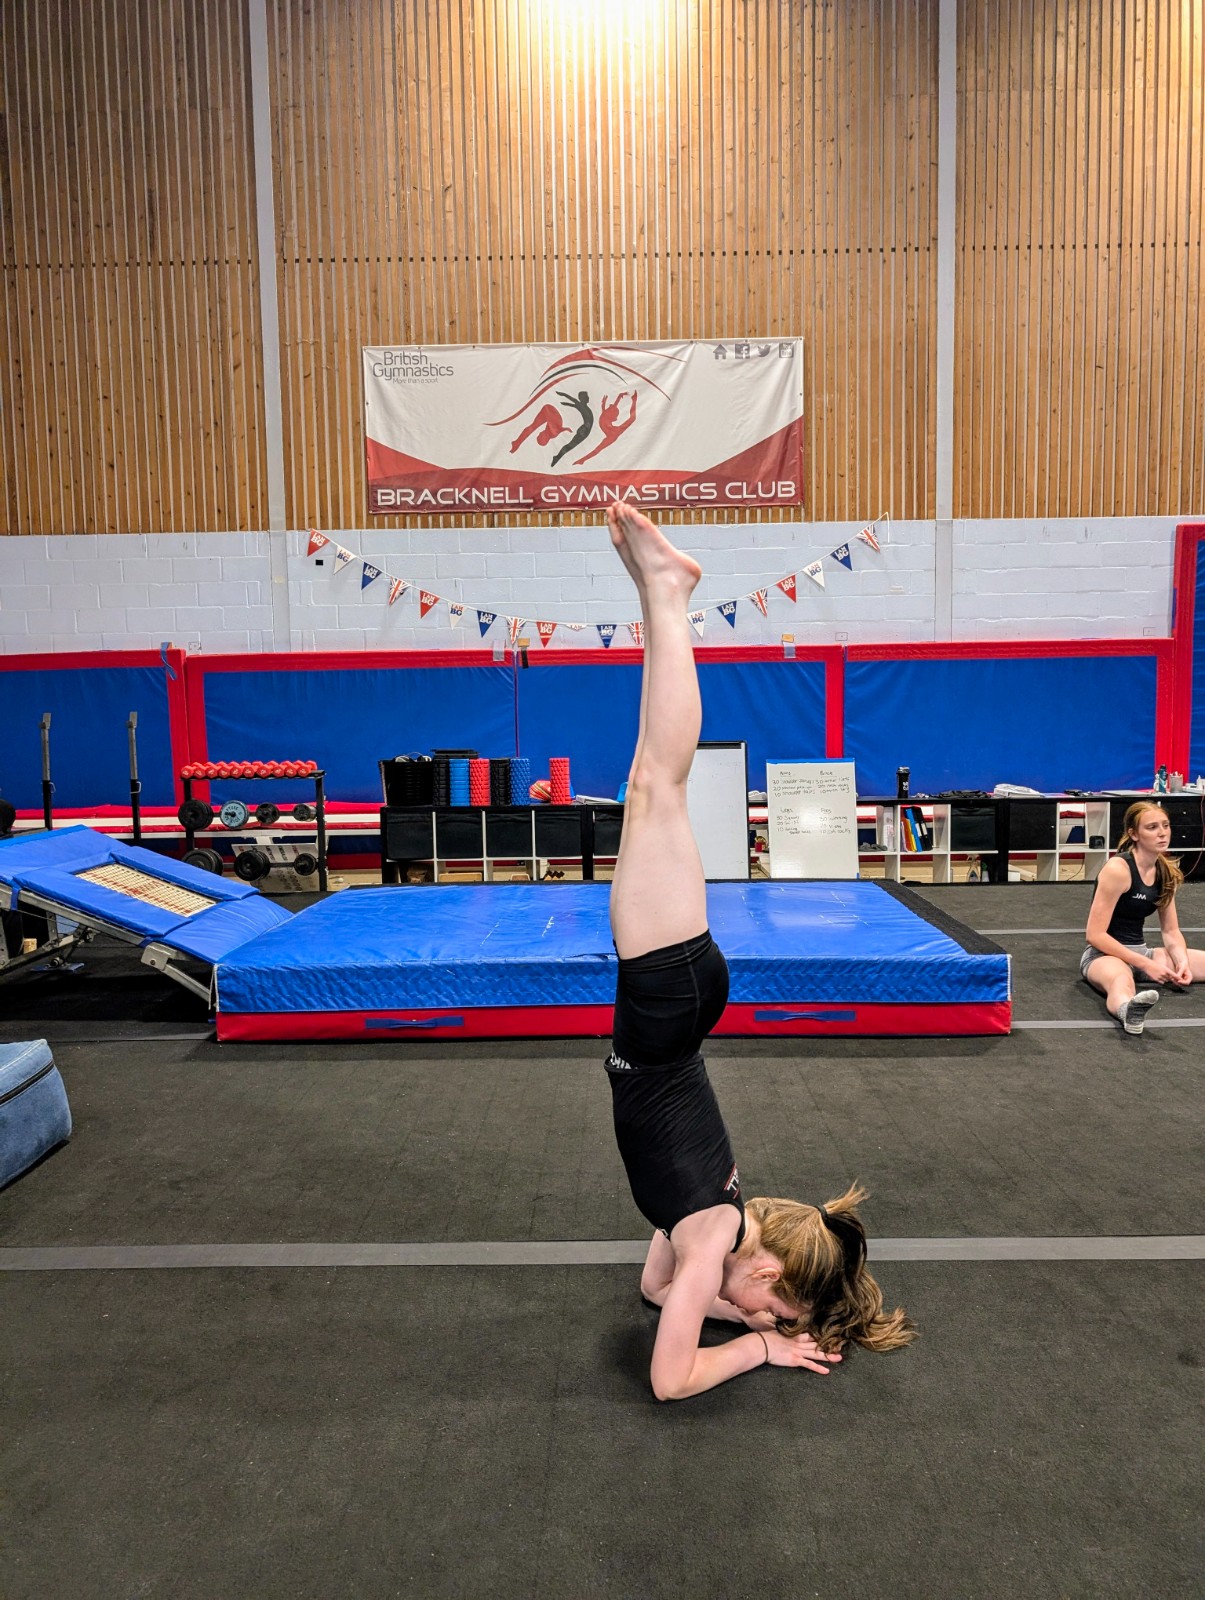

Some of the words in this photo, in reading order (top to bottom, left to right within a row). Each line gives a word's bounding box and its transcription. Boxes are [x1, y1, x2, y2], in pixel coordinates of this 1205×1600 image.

[383, 351, 428, 365] British
[372, 362, 454, 381] Gymnastics
[377, 486, 533, 506] BRACKNELL
[540, 482, 718, 503] GYMNASTICS
[725, 481, 796, 499] CLUB
[311, 537, 324, 546] BG
[336, 552, 348, 562] BG
[837, 551, 849, 560] BG
[364, 569, 376, 578] BG
[809, 567, 822, 576] BG
[782, 582, 795, 591] BG
[422, 597, 434, 606] BG
[450, 608, 462, 616] BG
[723, 607, 735, 616] BG
[692, 616, 704, 624] BG
